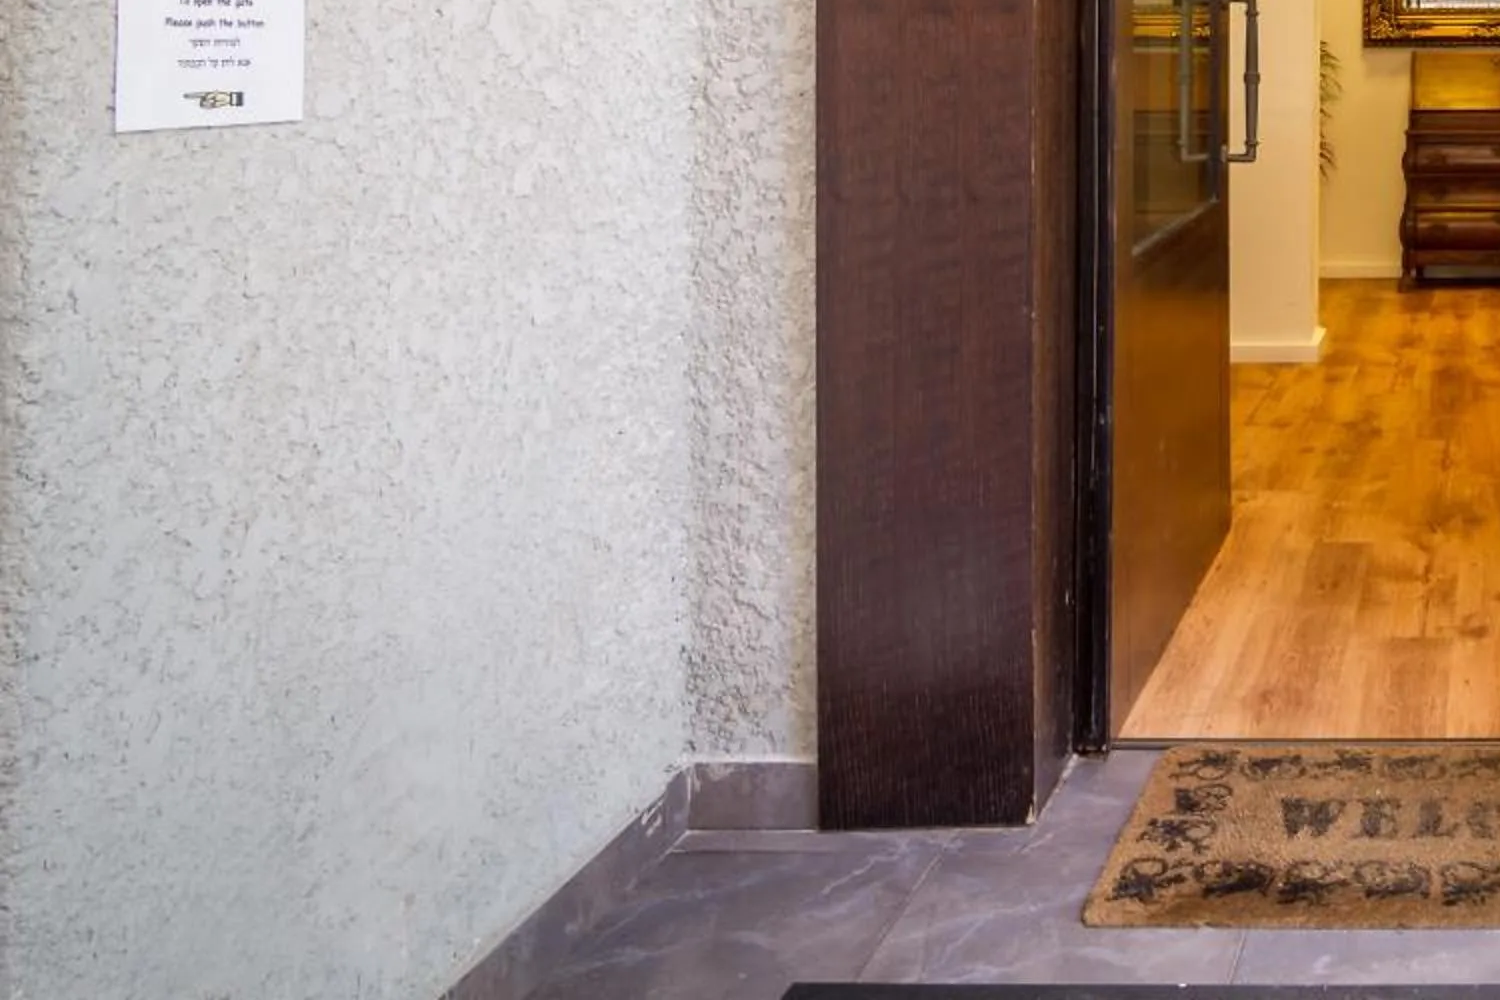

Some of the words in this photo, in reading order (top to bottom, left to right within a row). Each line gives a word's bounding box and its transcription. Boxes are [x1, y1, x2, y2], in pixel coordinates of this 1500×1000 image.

[165, 17, 193, 28] Please
[196, 18, 216, 29] push
[219, 18, 233, 28] the
[237, 18, 265, 28] button
